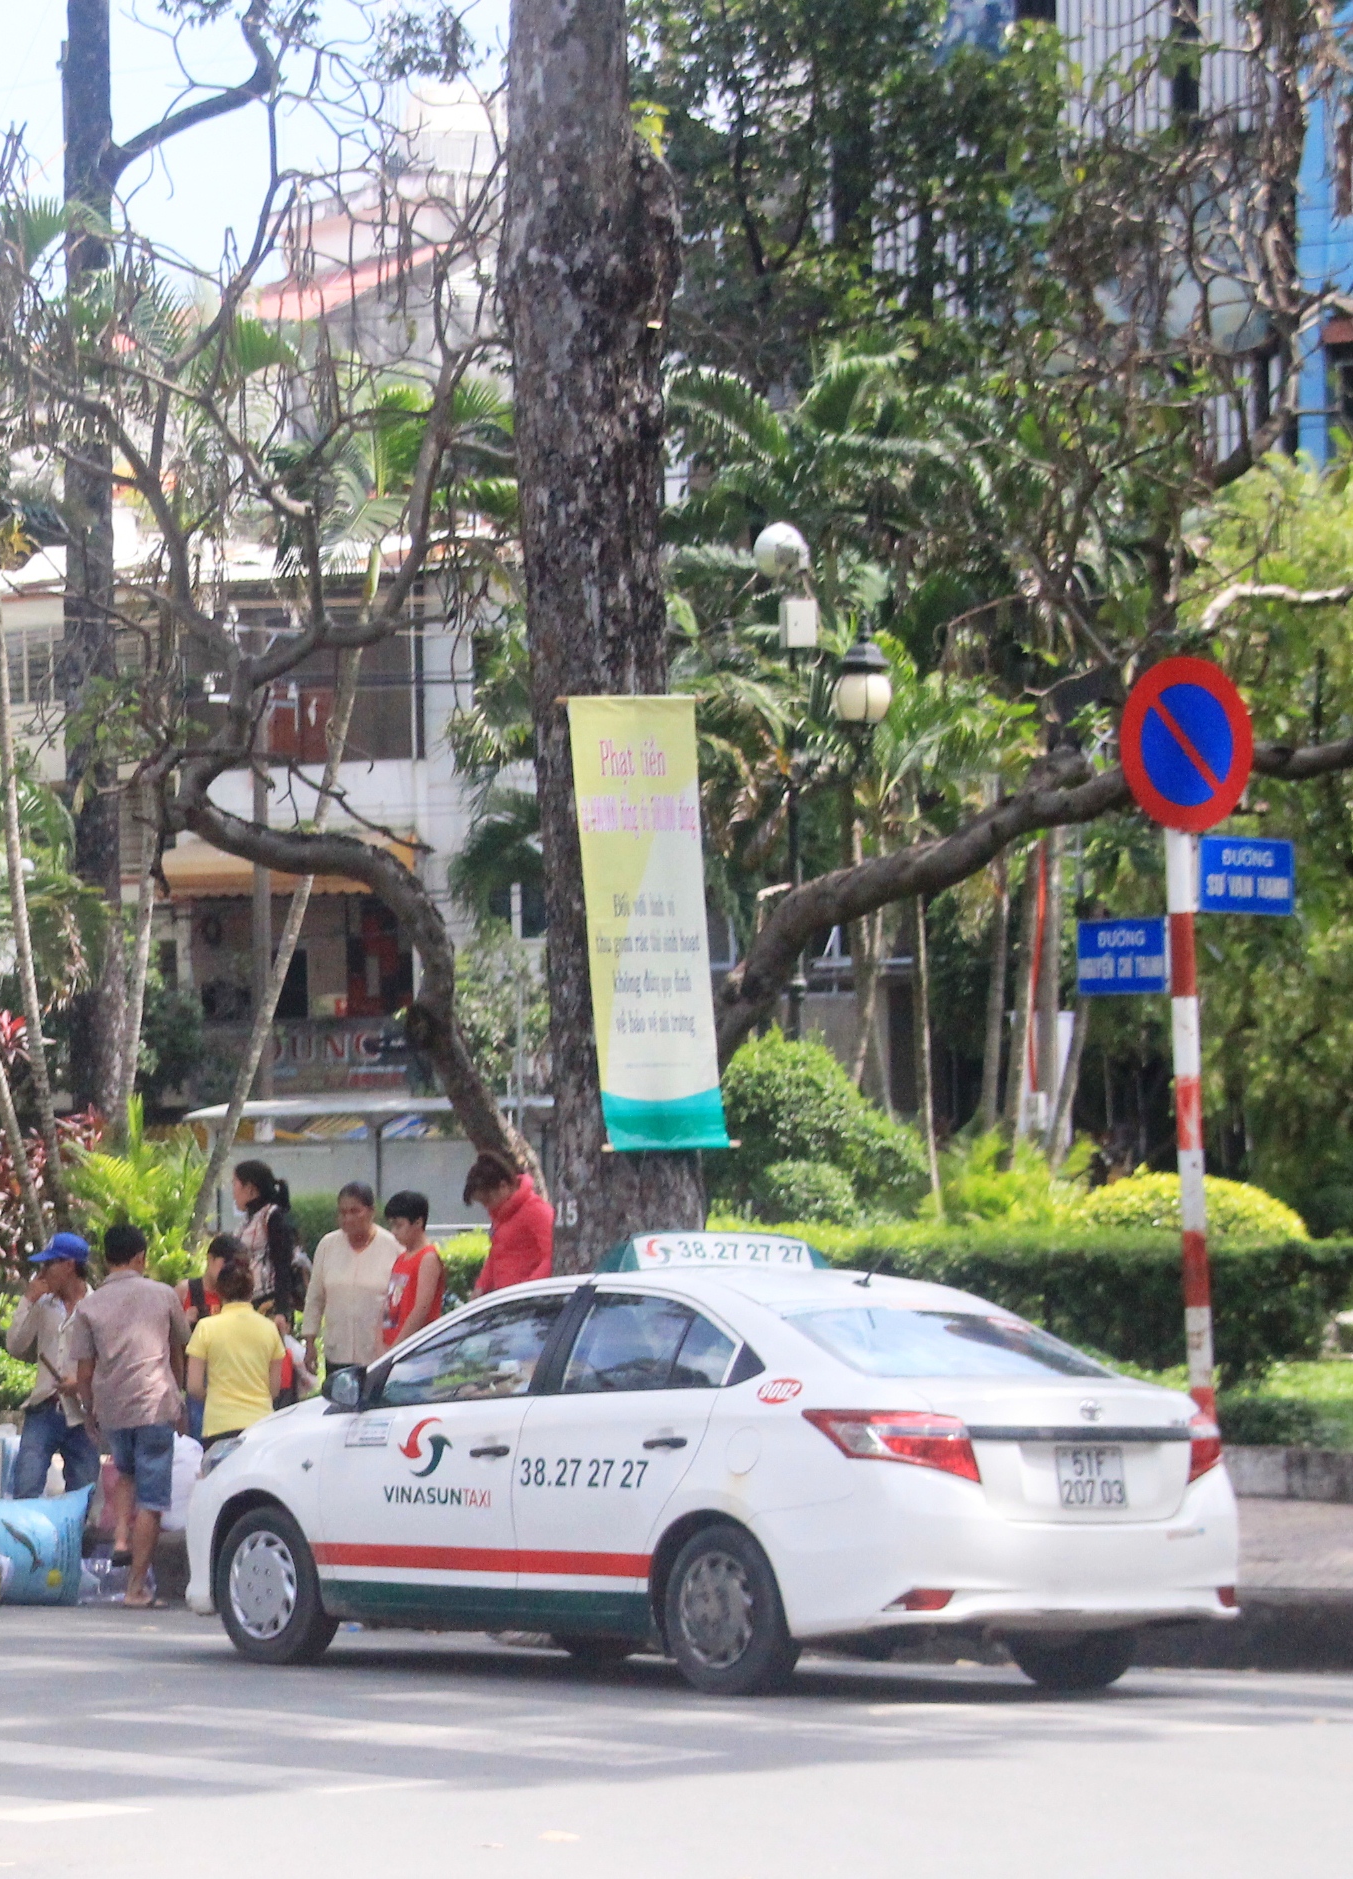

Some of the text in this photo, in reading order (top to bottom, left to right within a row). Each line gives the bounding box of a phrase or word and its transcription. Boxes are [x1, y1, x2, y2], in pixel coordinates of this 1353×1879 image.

[677, 1240, 803, 1263] 38.27 27 27
[520, 1458, 649, 1488] 38.27 27 27
[1072, 1449, 1105, 1476] 51F
